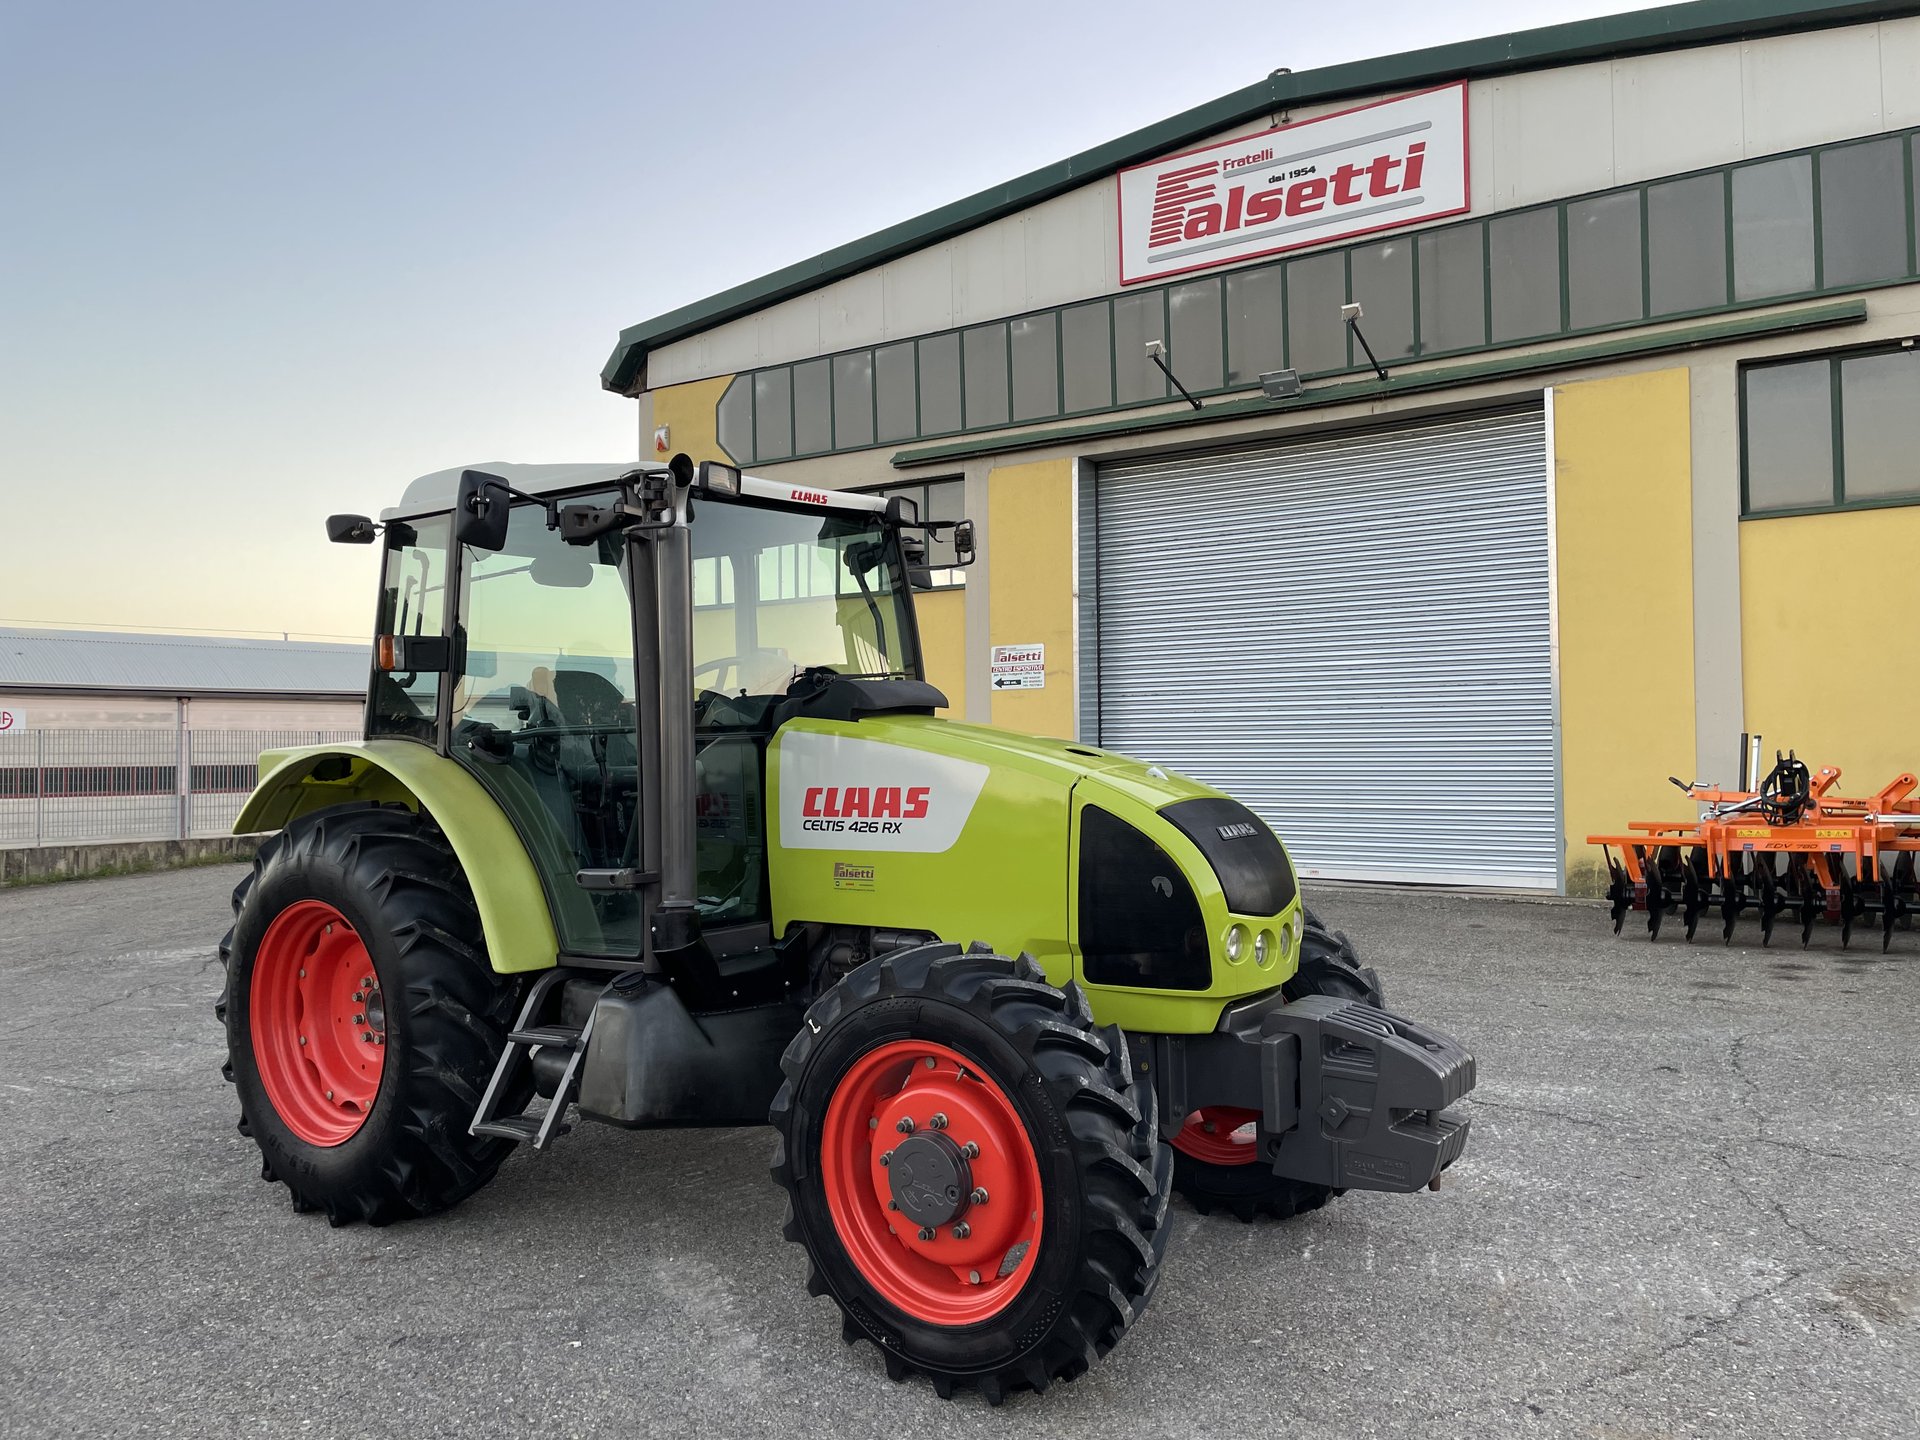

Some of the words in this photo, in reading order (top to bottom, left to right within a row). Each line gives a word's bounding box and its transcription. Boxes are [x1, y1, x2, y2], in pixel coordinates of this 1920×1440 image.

[1222, 148, 1273, 171] Fratelli
[1268, 173, 1286, 184] dal
[1288, 165, 1316, 180] 1954
[1149, 141, 1427, 249] Falsetti
[791, 490, 828, 504] CLAAS
[803, 787, 930, 819] CLAAS
[803, 820, 845, 832] CELTIS
[848, 821, 879, 833] 426
[882, 822, 903, 834] RX
